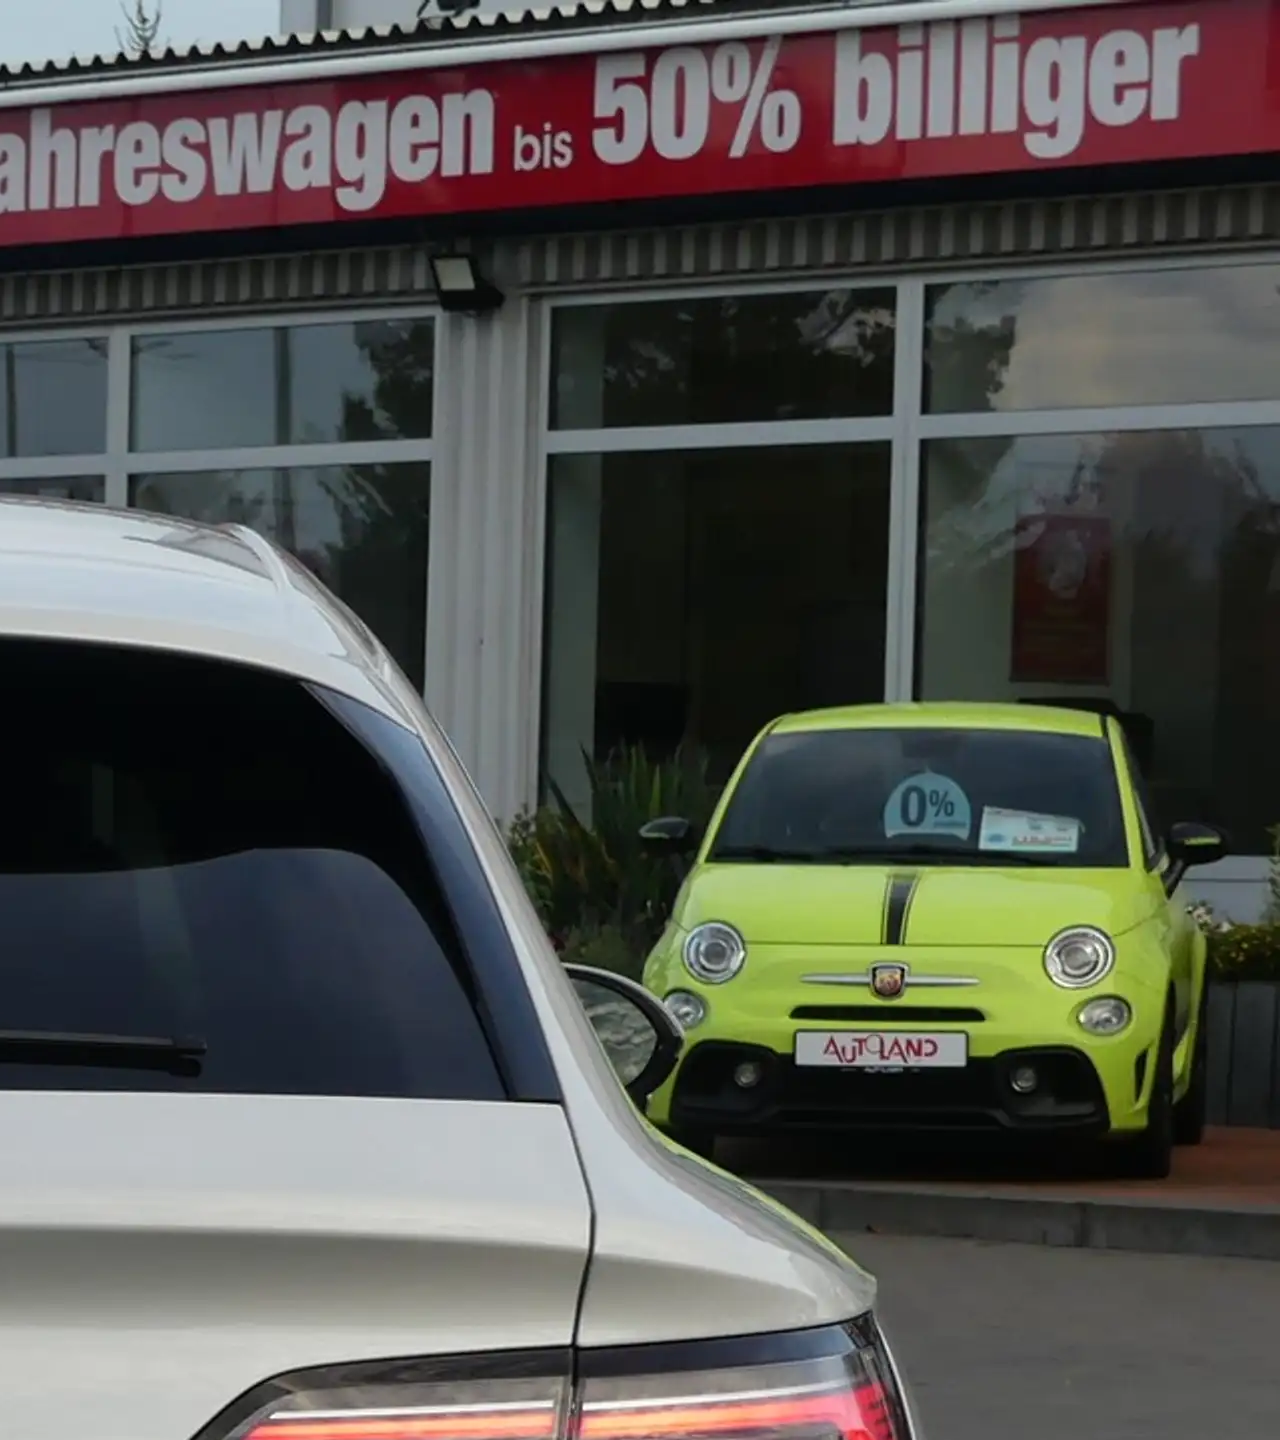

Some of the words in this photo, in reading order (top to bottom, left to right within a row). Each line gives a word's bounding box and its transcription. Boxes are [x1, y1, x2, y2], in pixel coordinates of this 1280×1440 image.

[513, 122, 573, 172] bis
[591, 34, 802, 166] 50%
[831, 15, 1201, 160] billiger
[899, 785, 956, 828] 0%
